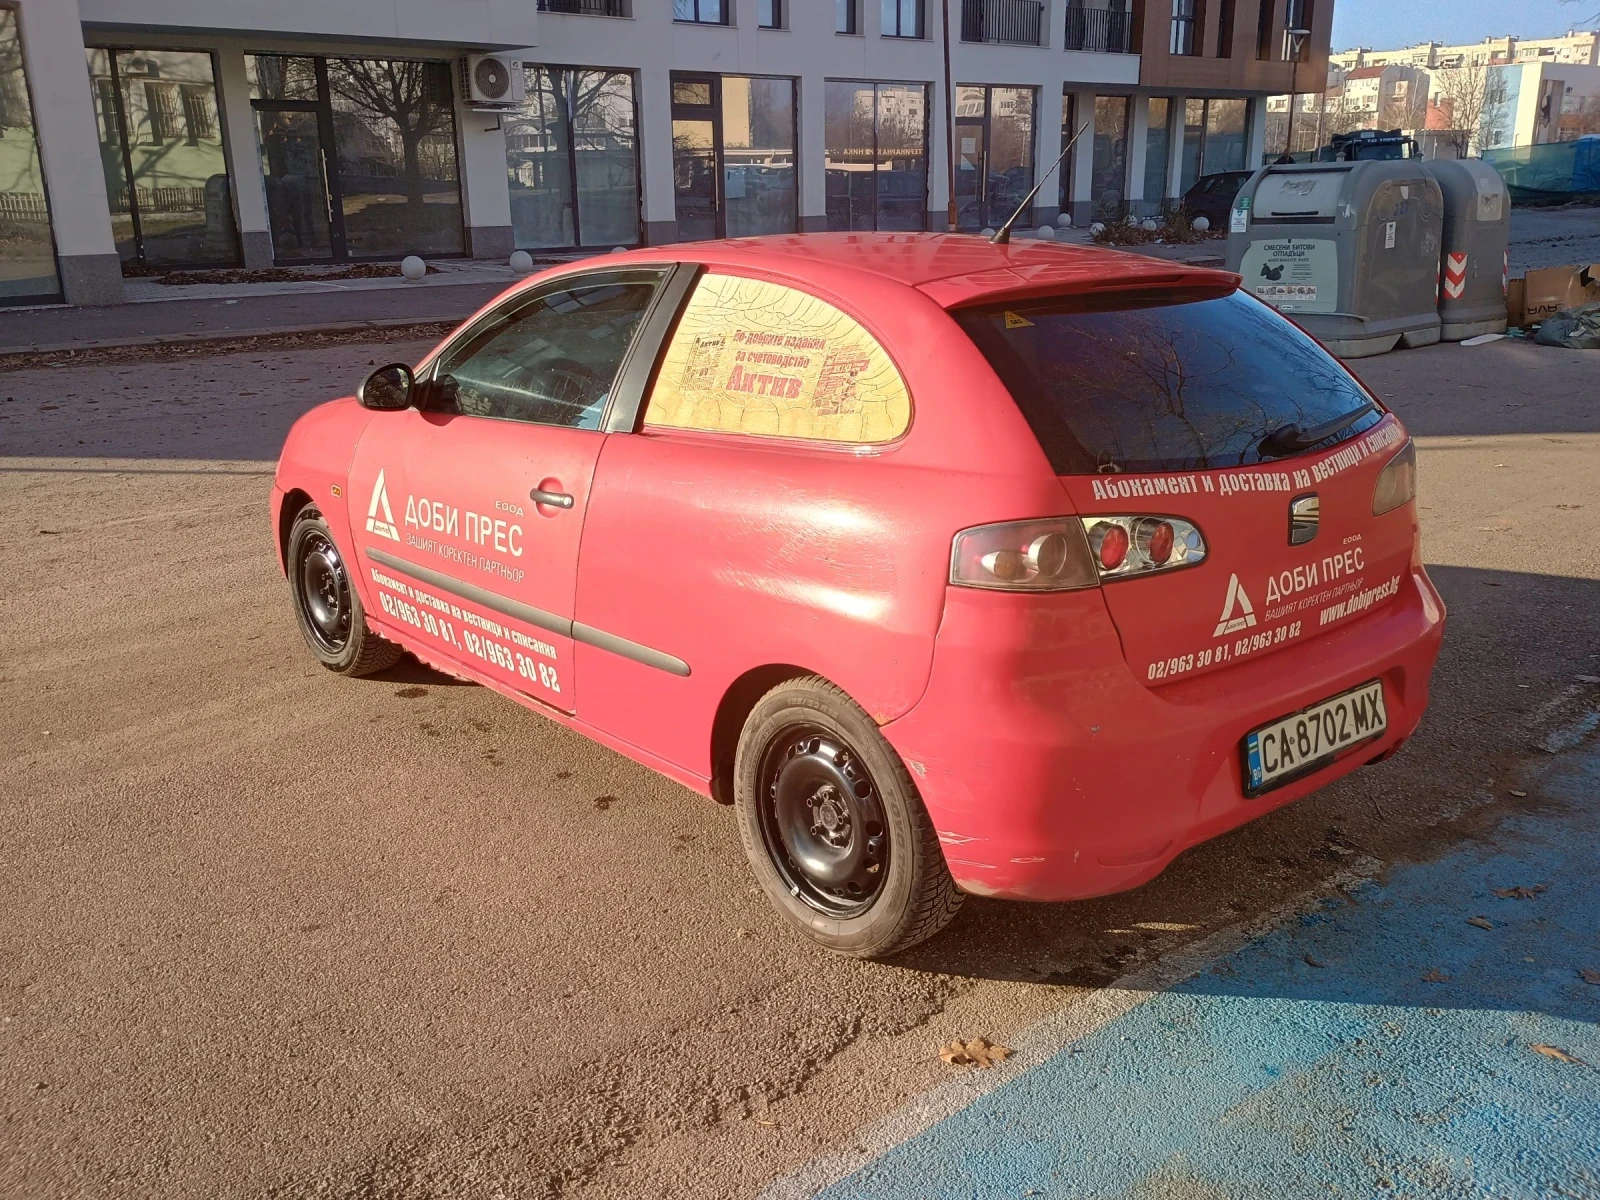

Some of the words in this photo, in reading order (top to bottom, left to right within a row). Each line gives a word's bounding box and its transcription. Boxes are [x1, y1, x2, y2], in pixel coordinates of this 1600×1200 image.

[1272, 250, 1305, 258] ОТПАДЪЦИ
[1291, 243, 1315, 251] БИТОВИ
[735, 350, 746, 362] за
[784, 335, 826, 350] издания
[726, 365, 803, 399] Актив
[1091, 475, 1198, 500] Абонамент
[1201, 475, 1215, 492] и
[1219, 473, 1291, 496] доставка
[1293, 469, 1311, 490] на
[1311, 444, 1362, 483] вестници
[1358, 440, 1370, 458] и
[404, 494, 458, 537] ДОБИ
[465, 511, 523, 557] ПРЕС
[495, 500, 524, 517] ЕООД
[438, 543, 478, 568] КОРЕКТЕН
[479, 557, 525, 583] ПАРТНЬОР
[1265, 562, 1318, 606] ДОБИ
[1322, 547, 1365, 582] ПРЕС
[371, 567, 408, 596] Абонамент
[407, 586, 415, 599] и
[414, 589, 451, 615] доставка
[450, 604, 462, 620] на
[462, 609, 503, 638] вестници
[503, 626, 511, 641] и
[511, 630, 557, 660] списания
[1264, 601, 1297, 621] ВАШИЯТ
[1298, 592, 1331, 611] КОРЕКТЕН
[1332, 577, 1364, 599] ПАРТНЬОР
[1320, 575, 1401, 626] www.dobipress.bg
[379, 590, 422, 629] 02/963
[420, 610, 439, 637] 30
[463, 629, 515, 672] 02/963
[515, 652, 537, 682] 30
[538, 662, 561, 693] 82
[1147, 654, 1194, 680] 02/963
[1197, 649, 1212, 668] 30
[1234, 630, 1273, 657] 02/963
[1274, 626, 1287, 644] 30
[1288, 620, 1301, 638] 82
[1252, 767, 1262, 781] BG
